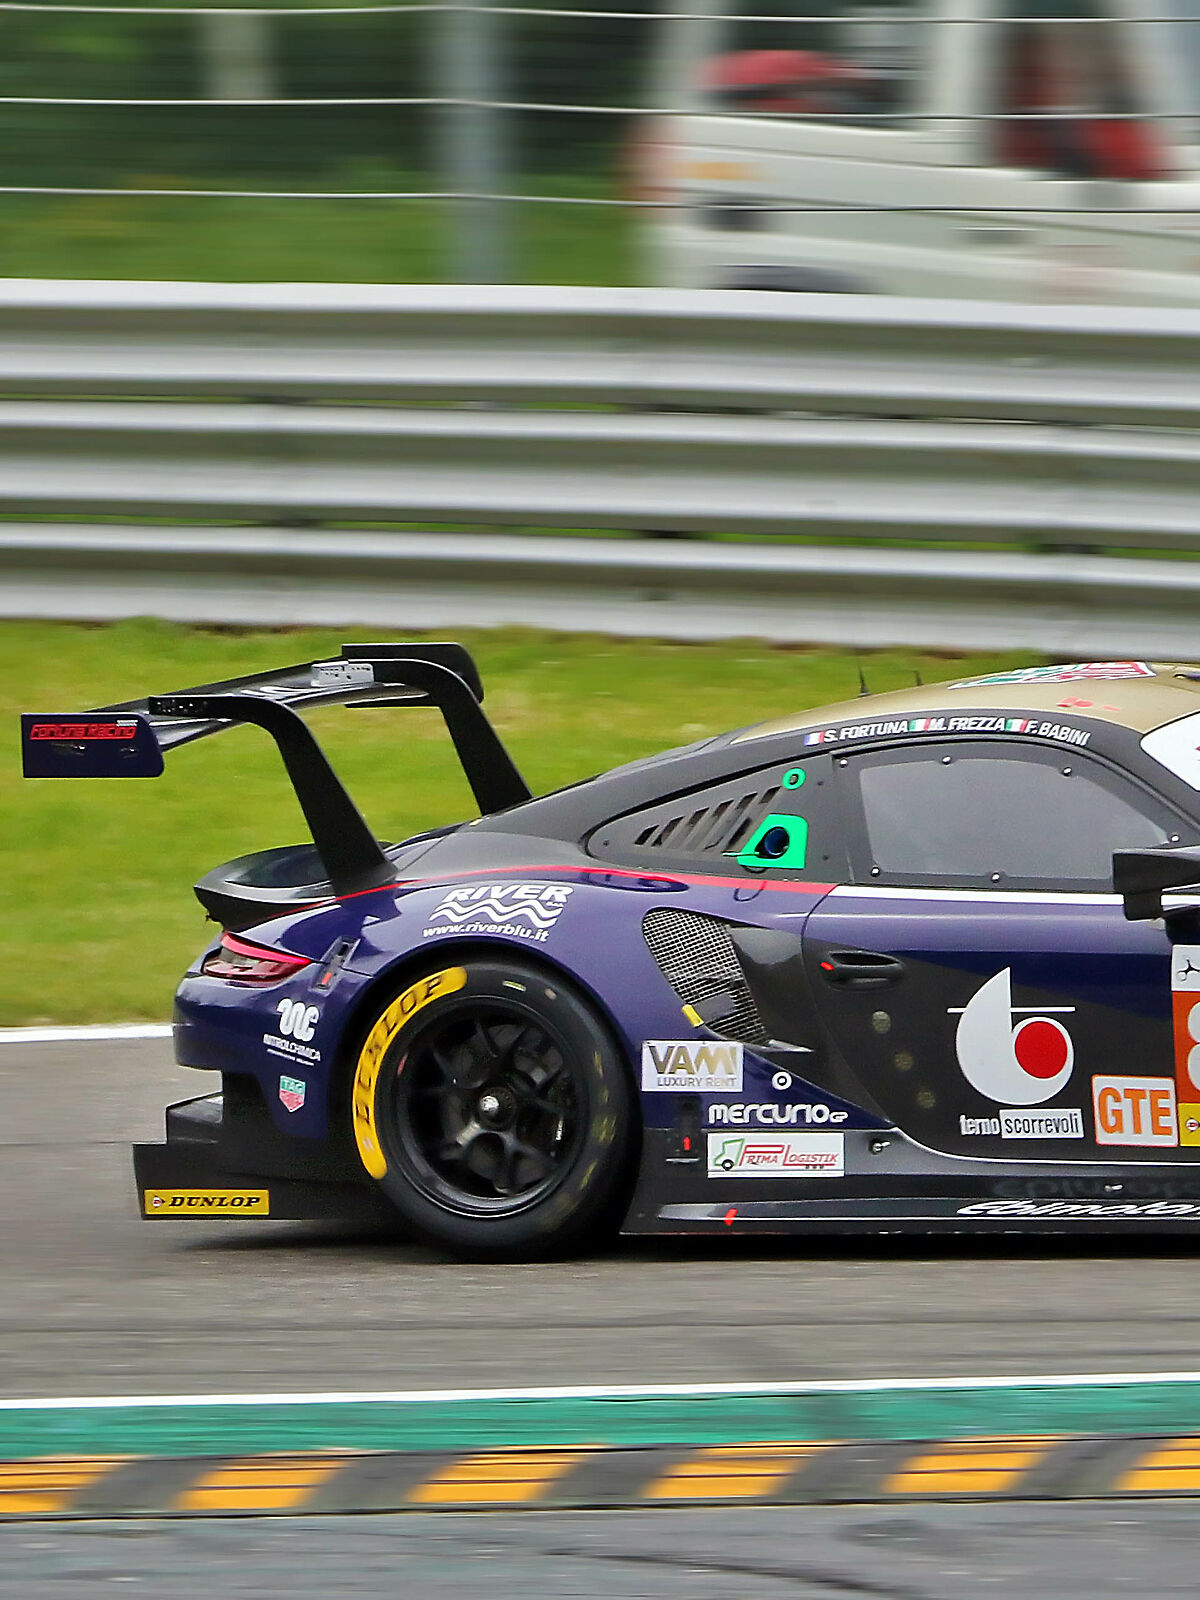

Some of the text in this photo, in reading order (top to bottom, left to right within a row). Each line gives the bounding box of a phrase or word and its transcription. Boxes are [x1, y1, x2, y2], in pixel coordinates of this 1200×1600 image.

[442, 885, 574, 902] RIVER
[423, 921, 550, 942] www.riverblu.it
[657, 1077, 737, 1087] LUXURY RENT
[1098, 1086, 1173, 1136] GTE
[960, 1112, 1080, 1135] terno scorrevoli
[168, 1196, 261, 1207] DUNLOP
